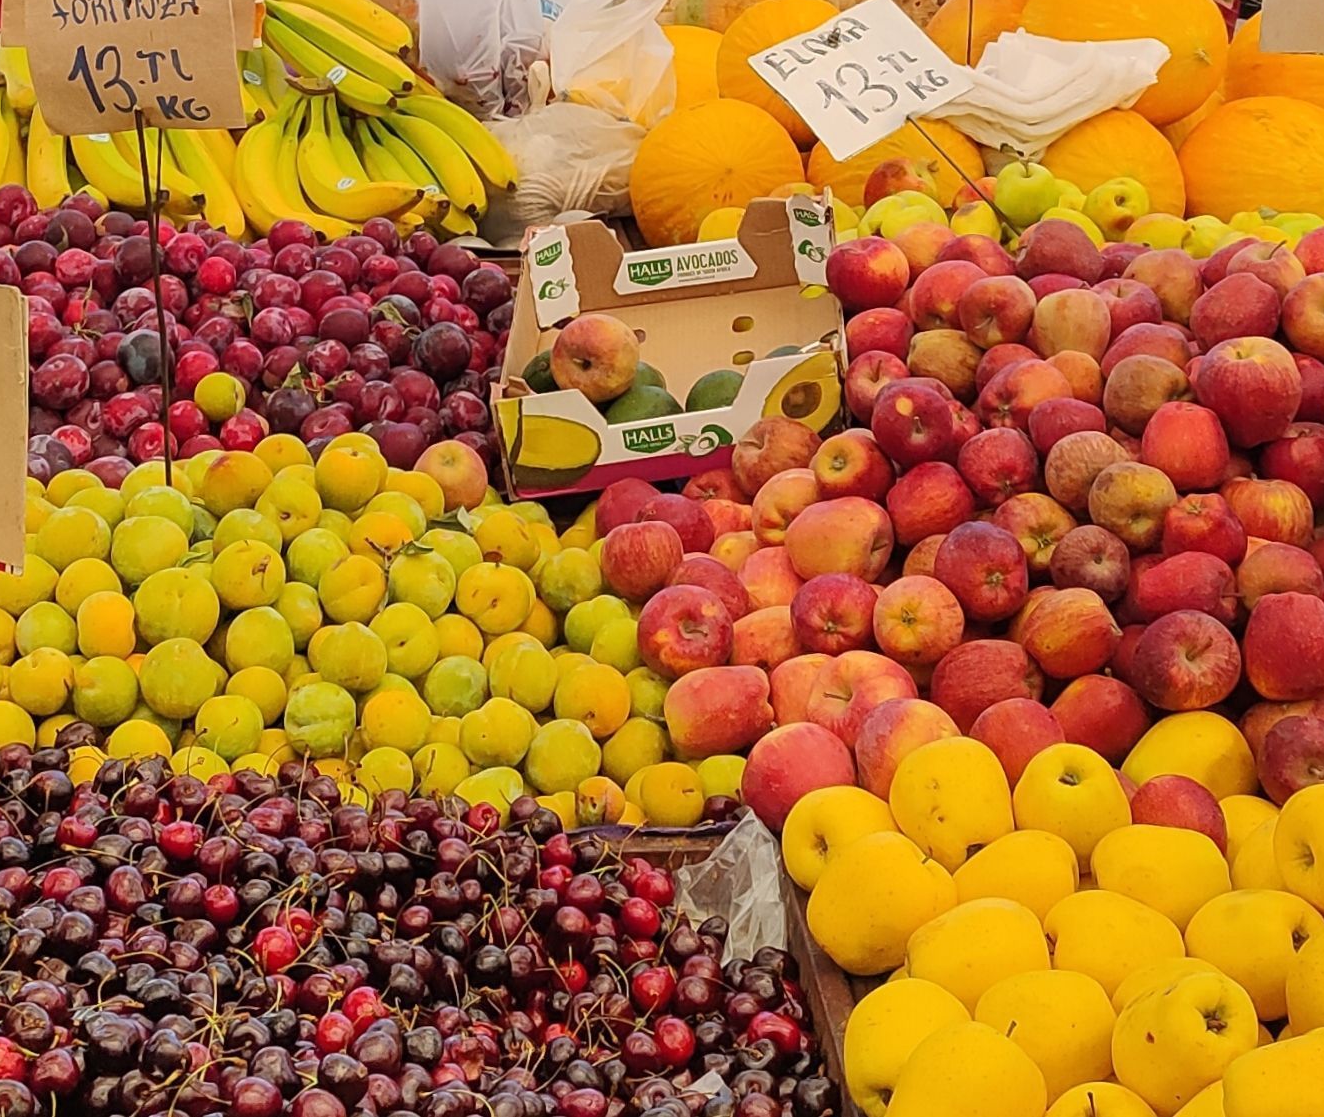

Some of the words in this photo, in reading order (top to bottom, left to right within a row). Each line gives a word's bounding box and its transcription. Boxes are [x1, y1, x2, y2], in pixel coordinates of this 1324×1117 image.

[68, 45, 138, 114] 13
[815, 62, 899, 124] 13
[906, 69, 950, 101] KG
[156, 95, 211, 122] KG
[630, 260, 671, 277] HALLS
[677, 249, 739, 272] AVOCADOS
[625, 426, 673, 446] HALLS
